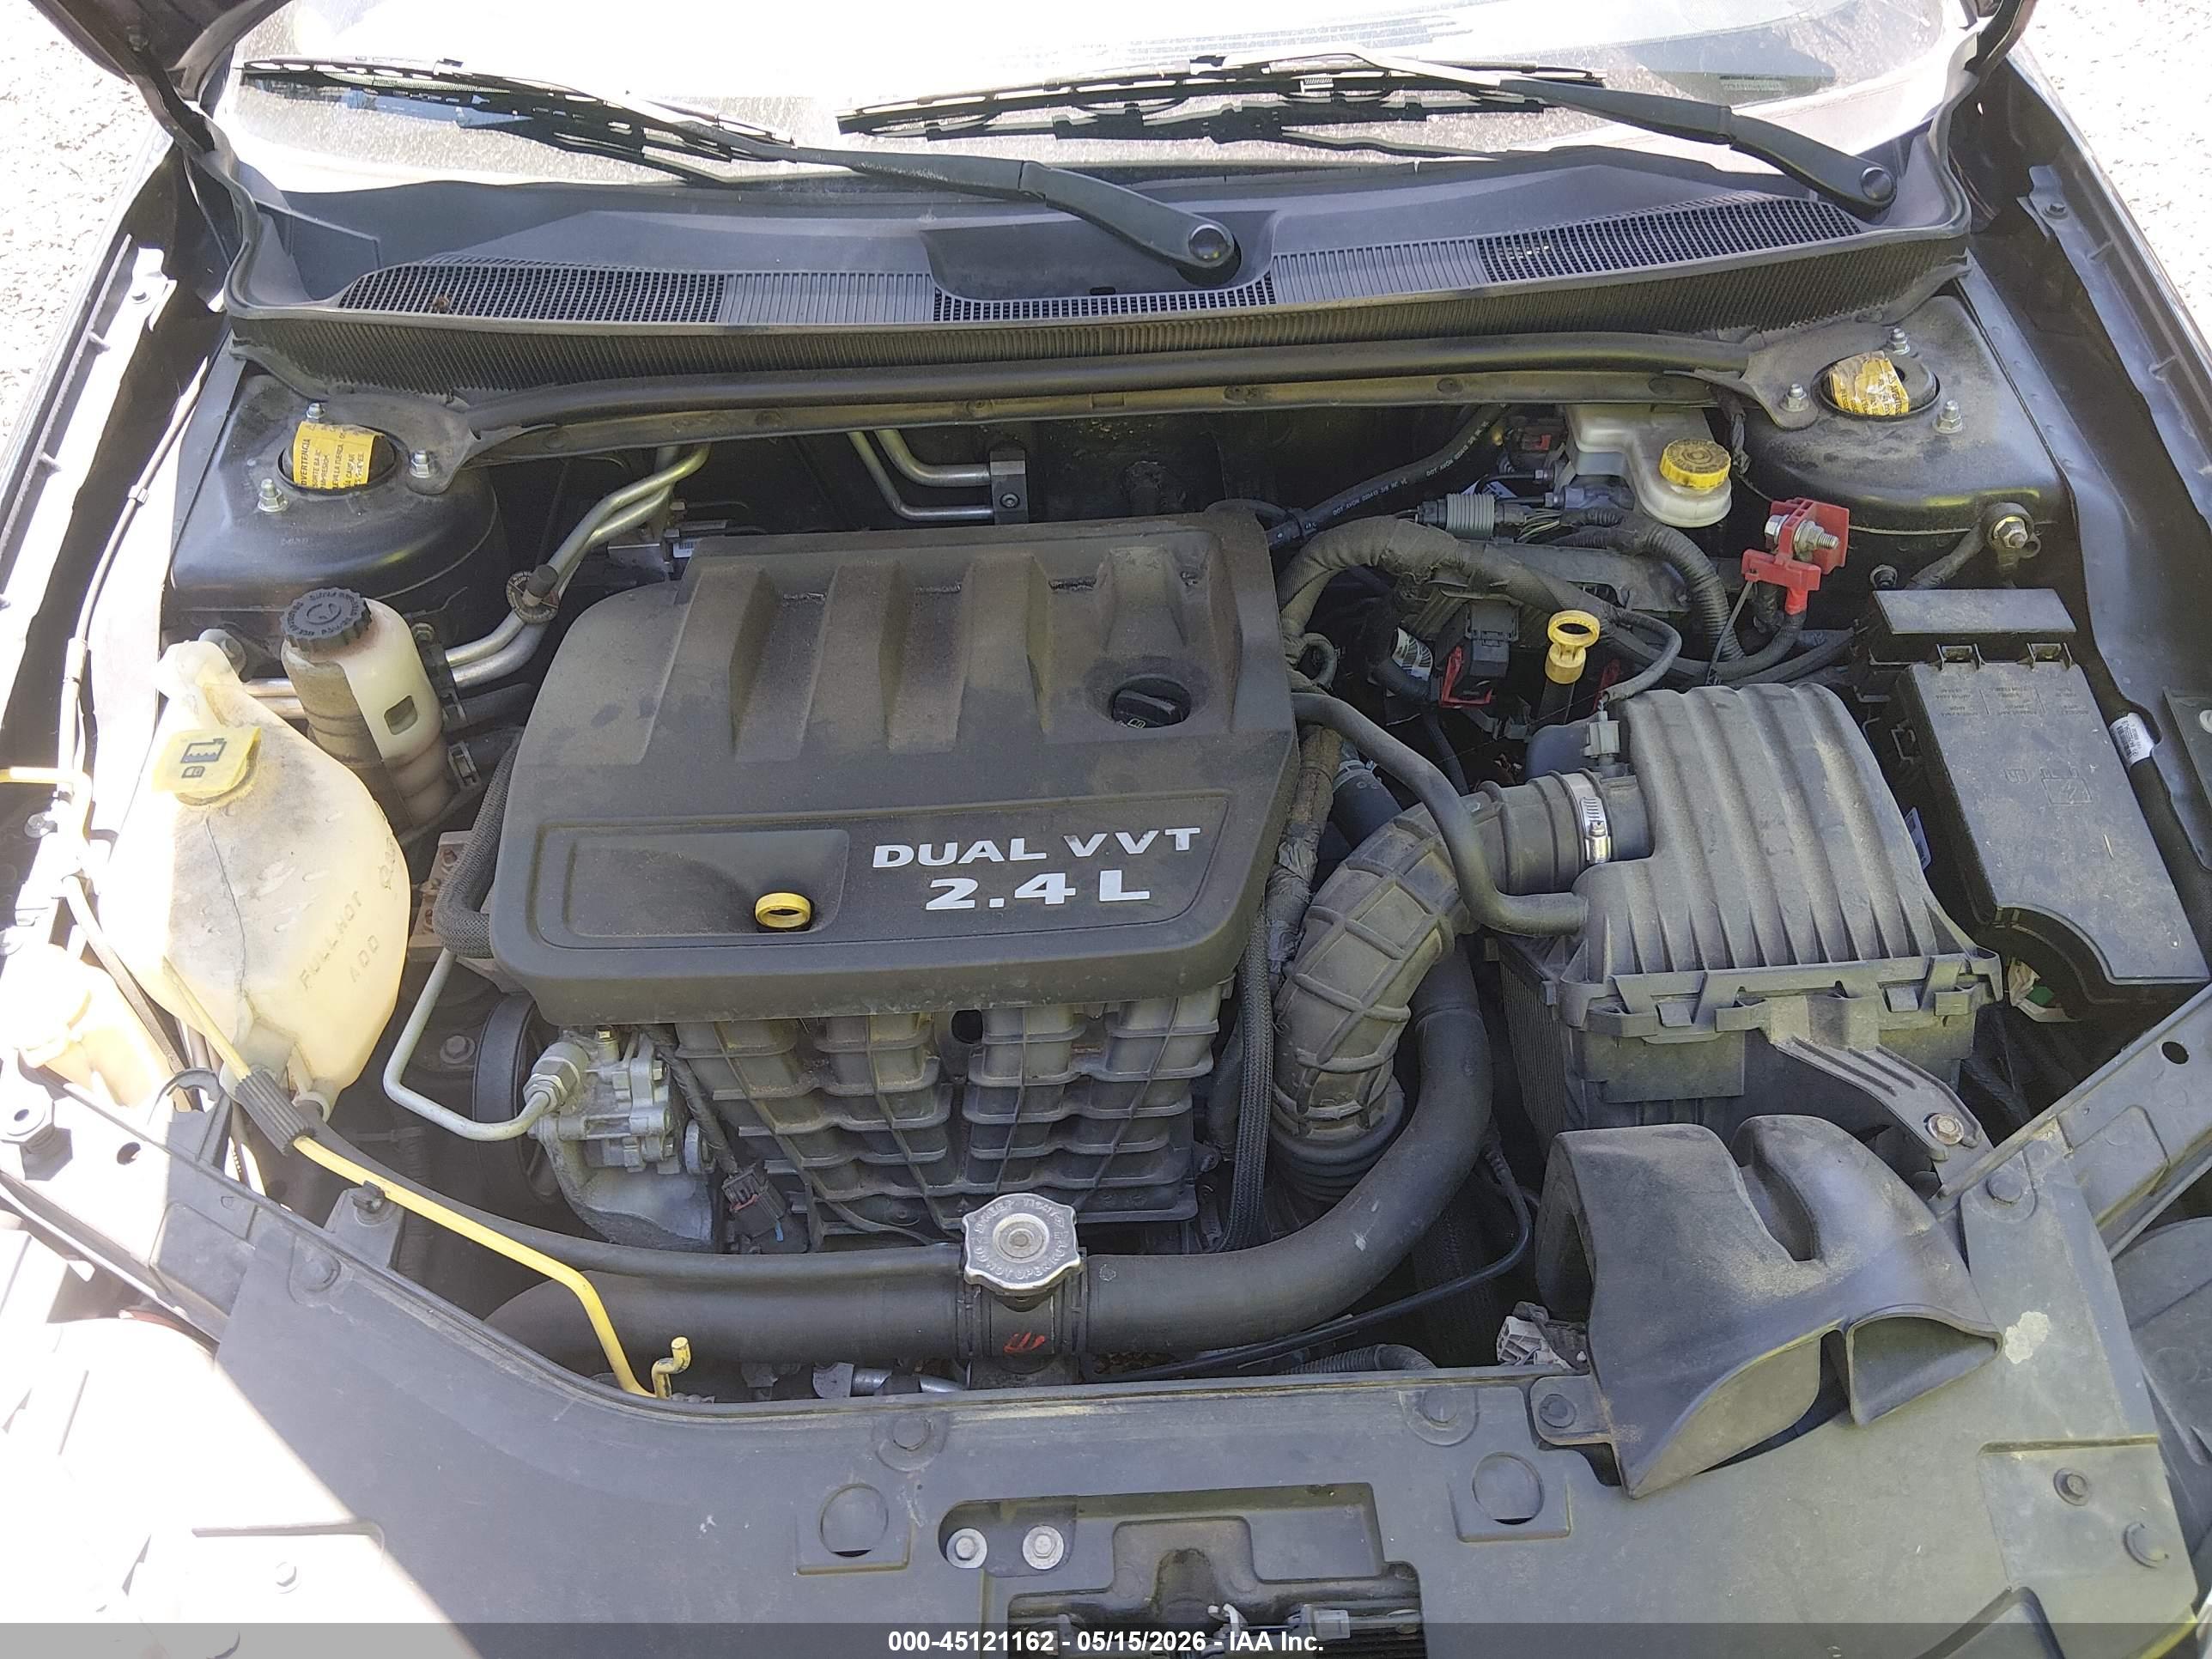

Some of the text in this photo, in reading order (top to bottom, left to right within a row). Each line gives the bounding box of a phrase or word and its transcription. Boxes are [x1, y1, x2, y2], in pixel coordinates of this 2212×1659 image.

[872, 828, 1200, 868] DUAL VVT
[926, 870, 1150, 910] 2.4 L
[349, 934, 380, 983] ADD
